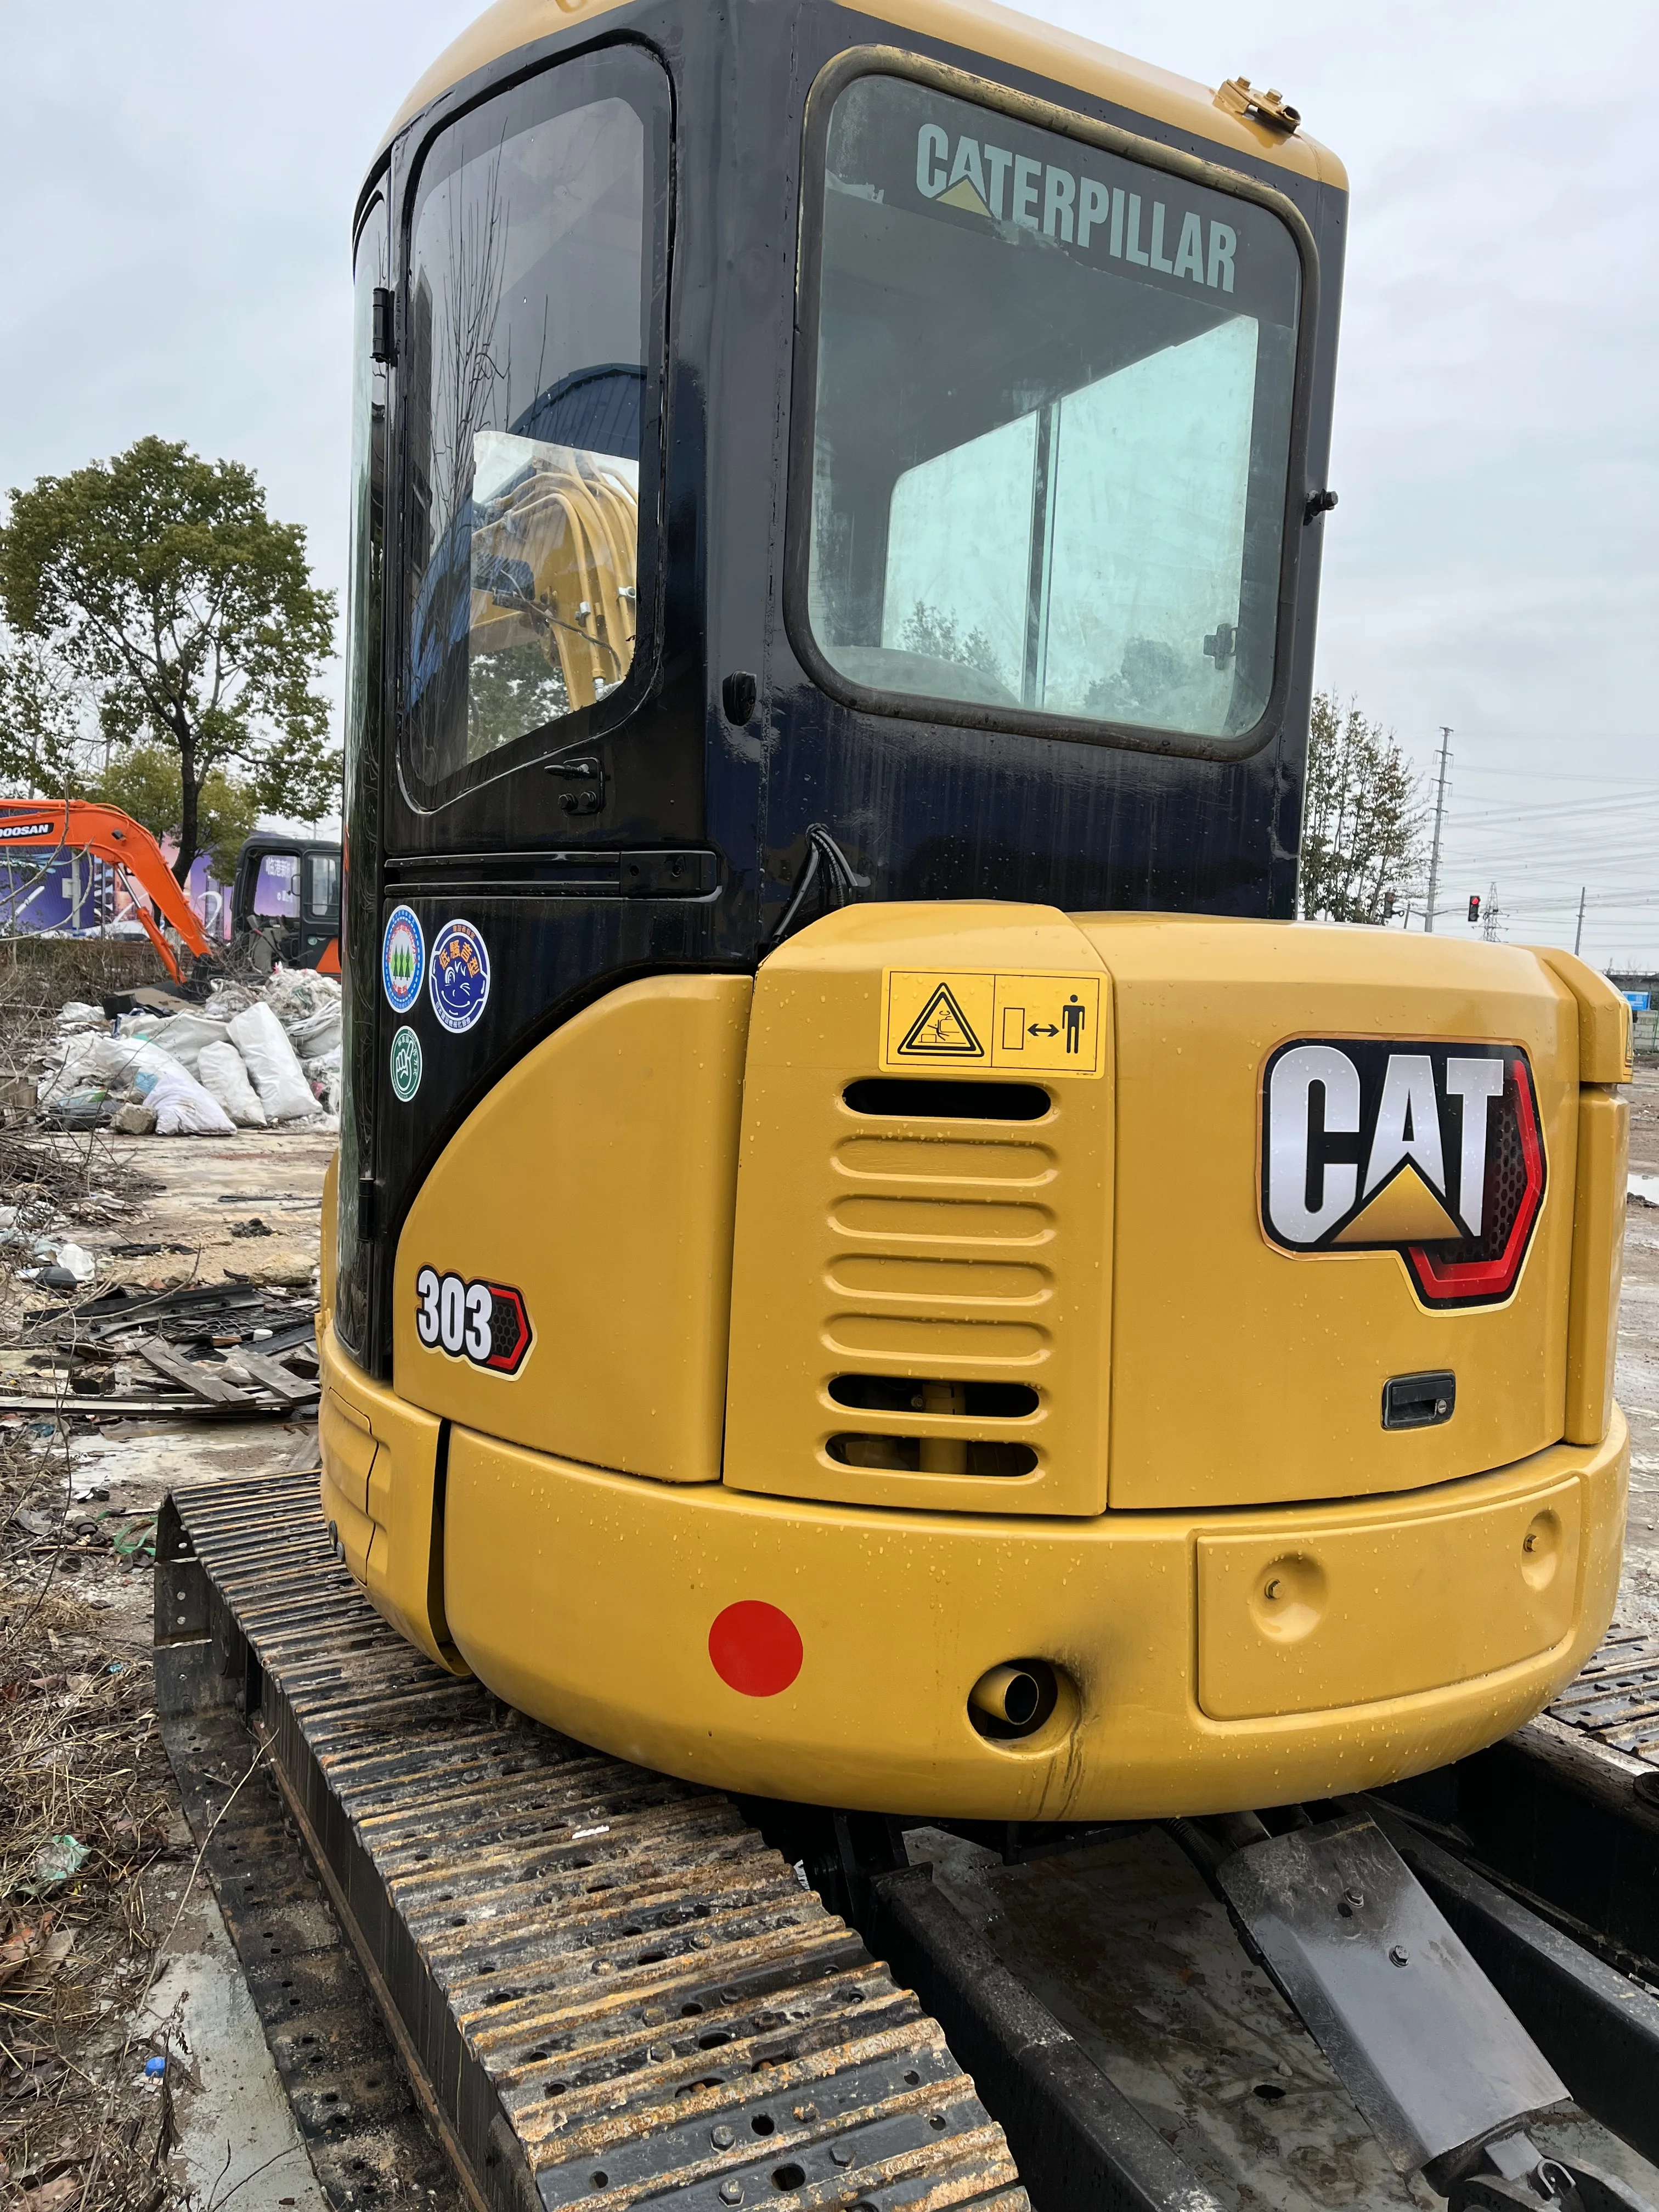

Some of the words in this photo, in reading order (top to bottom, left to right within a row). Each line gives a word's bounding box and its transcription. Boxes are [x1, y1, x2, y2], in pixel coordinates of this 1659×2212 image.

[916, 123, 1238, 294] CATERPILLAR
[1269, 1045, 1504, 1243] CAT
[417, 1269, 493, 1360] 303
